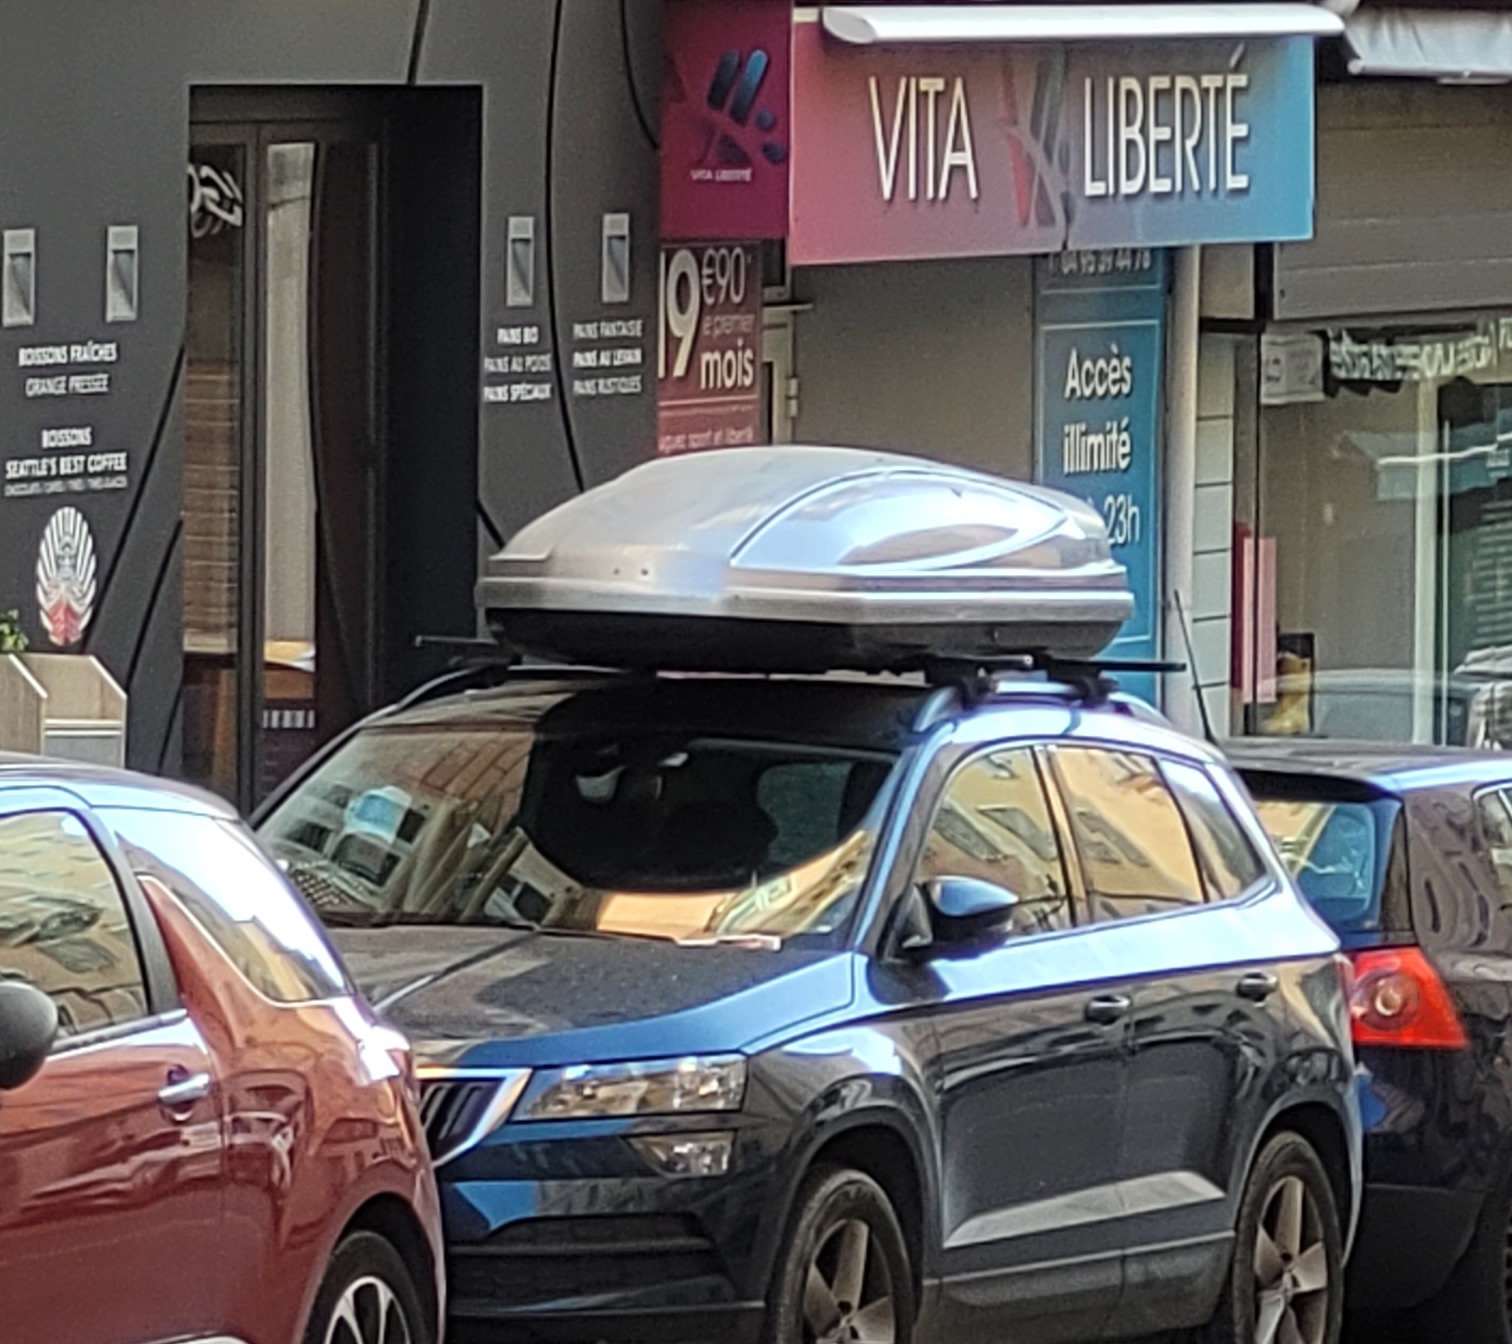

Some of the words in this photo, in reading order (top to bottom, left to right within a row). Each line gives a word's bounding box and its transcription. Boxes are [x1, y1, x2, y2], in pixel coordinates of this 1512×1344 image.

[869, 76, 980, 201] VITA
[1083, 43, 1249, 198] LIBERTÉ
[18, 346, 67, 367] BOISSONS
[700, 337, 754, 391] mois
[1064, 342, 1132, 400] Accès
[25, 376, 67, 397] ORANGE
[41, 427, 92, 448] BOISSONS
[1063, 416, 1132, 475] illimité
[87, 452, 128, 473] COFFEE
